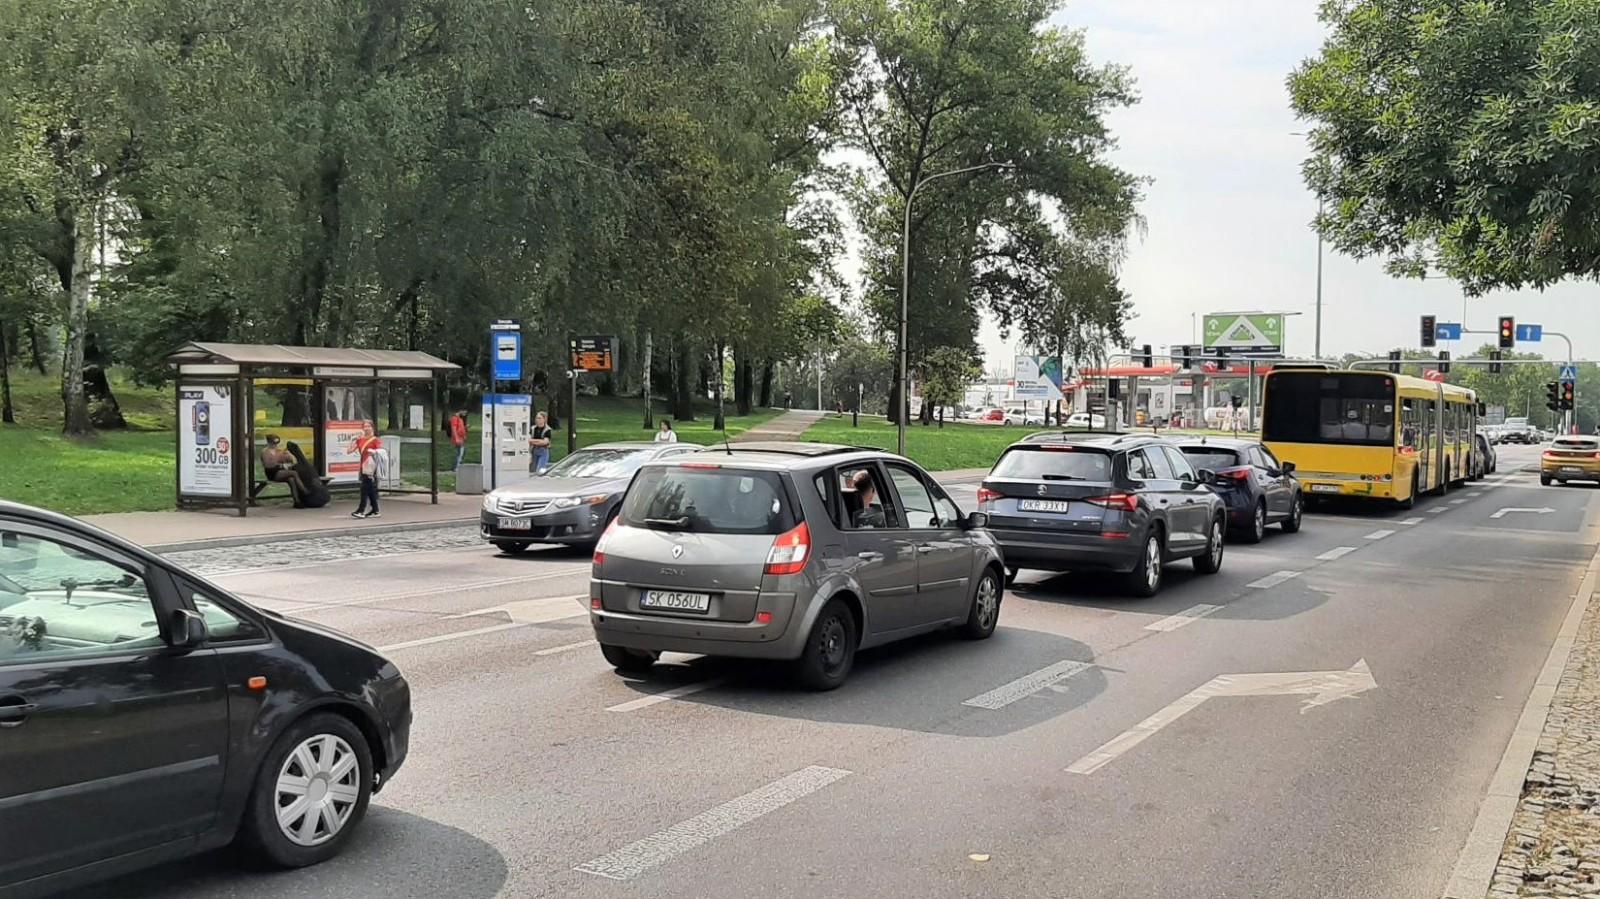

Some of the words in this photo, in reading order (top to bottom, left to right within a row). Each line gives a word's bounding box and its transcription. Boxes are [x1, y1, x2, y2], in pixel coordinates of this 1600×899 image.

[195, 447, 217, 464] 300
[218, 455, 229, 464] GB
[656, 567, 687, 576] SCENC
[648, 592, 664, 606] SK
[668, 593, 704, 609] 056UL
